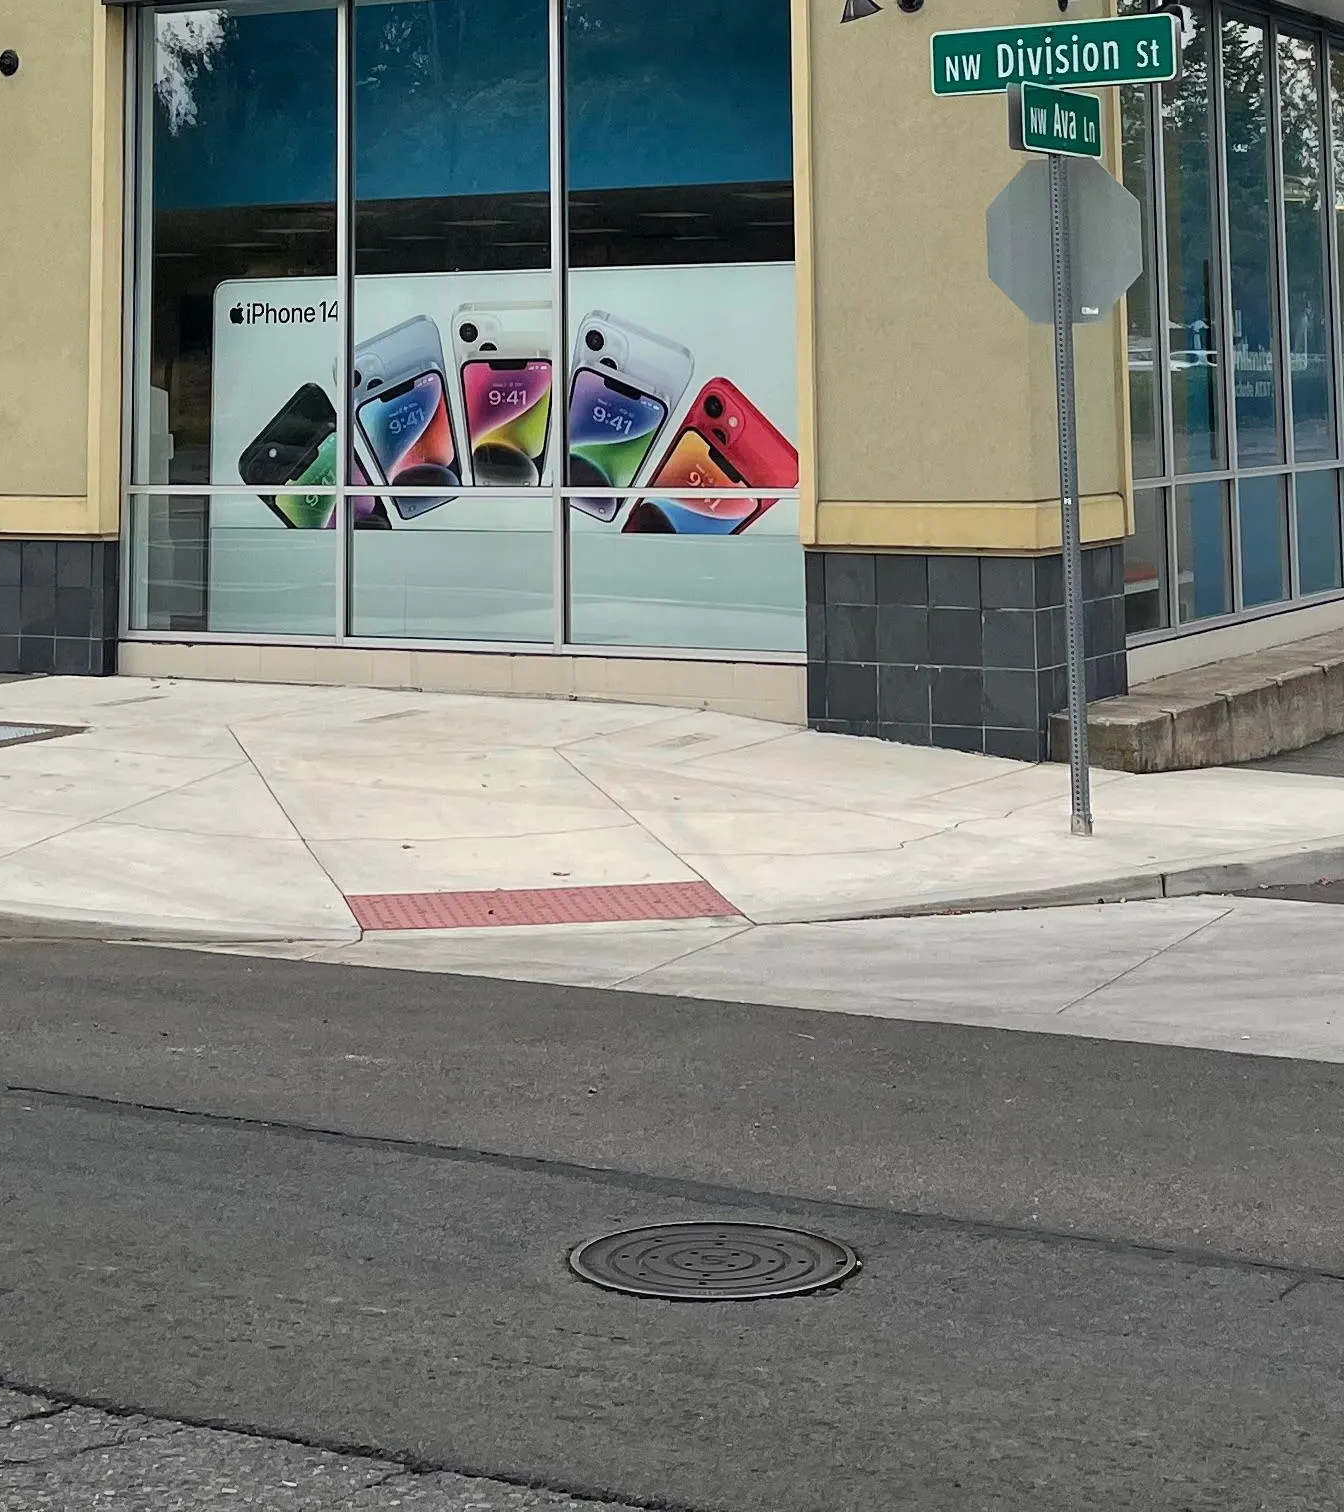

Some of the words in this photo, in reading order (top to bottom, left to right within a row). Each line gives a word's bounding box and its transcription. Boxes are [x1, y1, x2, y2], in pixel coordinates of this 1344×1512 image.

[944, 53, 981, 82] NW
[996, 34, 1119, 79] Division
[1136, 39, 1160, 68] St
[1030, 106, 1047, 135] NW
[1053, 102, 1077, 141] Ava
[1083, 116, 1096, 144] Ln
[246, 302, 316, 325] iPhone
[318, 300, 338, 323] 14
[488, 389, 527, 406] 9:41
[389, 407, 425, 435] 9:41
[592, 405, 633, 435] 9:41
